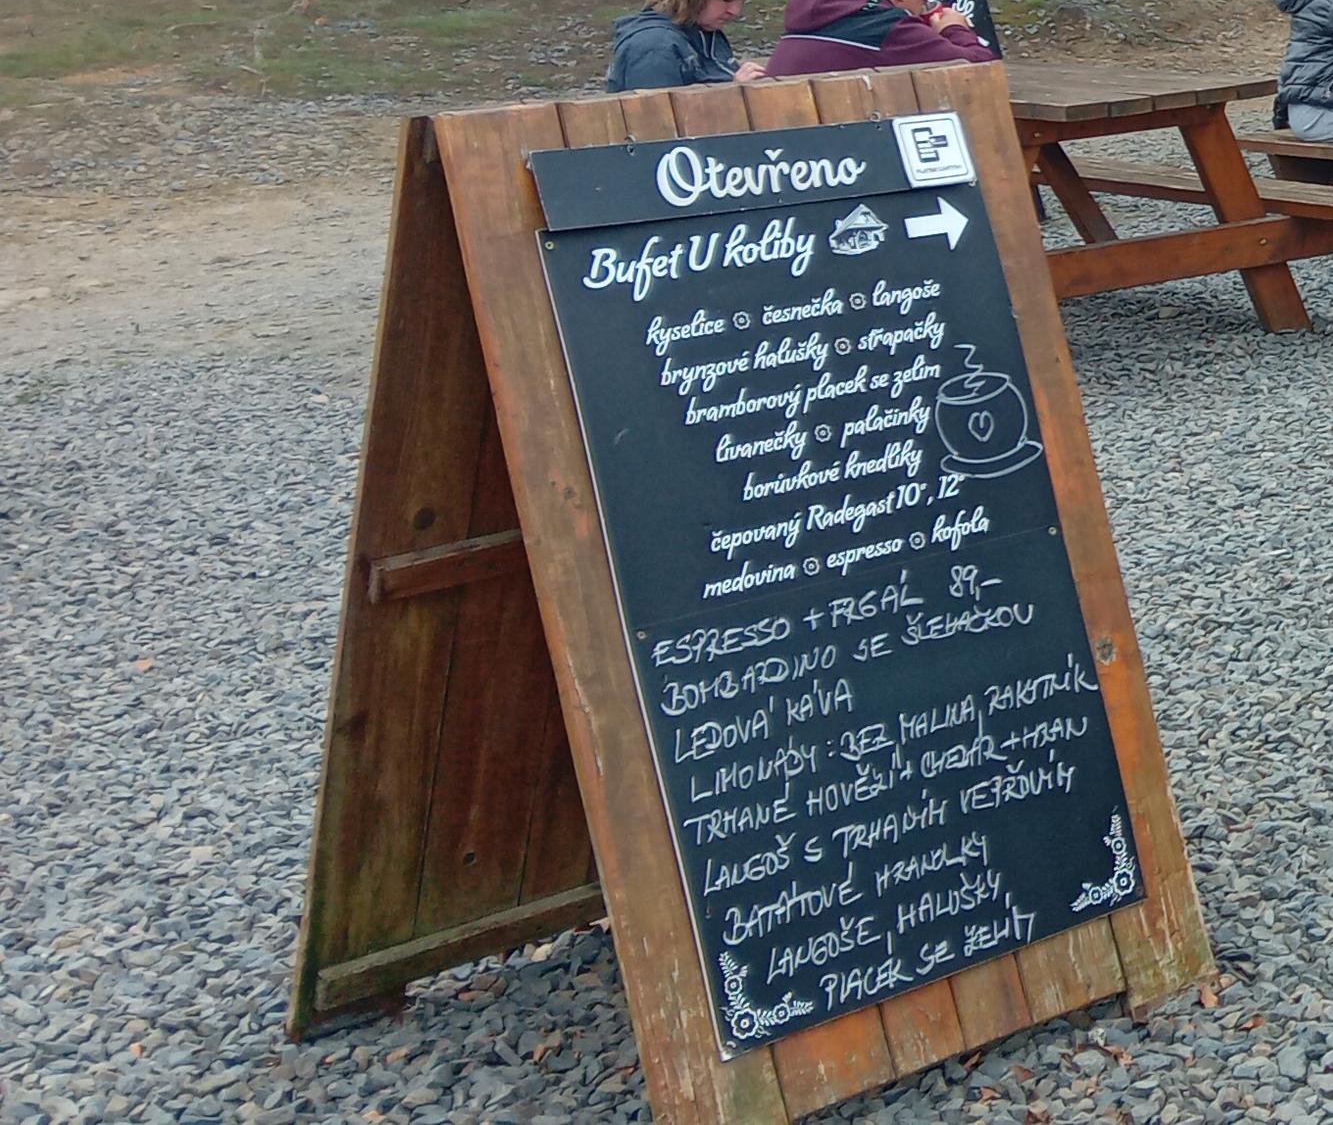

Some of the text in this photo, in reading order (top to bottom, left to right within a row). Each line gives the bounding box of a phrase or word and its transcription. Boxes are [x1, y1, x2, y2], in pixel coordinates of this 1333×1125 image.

[656, 146, 867, 207] Otevřeno
[583, 217, 816, 302] Bufet U koliby
[646, 279, 941, 357] kyselice česnečka langoše
[660, 351, 750, 396] brynzové
[753, 332, 829, 371] halušky
[685, 384, 802, 425] bramborový
[802, 365, 867, 413] placek
[869, 371, 889, 390] se
[840, 395, 932, 448] palačinky
[702, 506, 990, 599] medovina espresso kofola
[710, 512, 803, 560] čepovaný
[806, 491, 896, 533] Radegast
[651, 615, 791, 668] ESPRESSO
[659, 604, 1034, 716] BOMBARDINO SE ŠLEHAČKOU
[983, 654, 1099, 716] RAKYTNÍK
[674, 679, 855, 764] LEDOVÁ KÁVA
[682, 781, 797, 845] TRHANÉ
[921, 735, 1007, 779] CHEDAR
[704, 831, 797, 898] LANGOŠ
[804, 836, 825, 864] S
[723, 831, 990, 946] BATÁTOVÉ HRANOLKY
[819, 956, 914, 1012] PLACEK
[916, 940, 955, 975] SE
